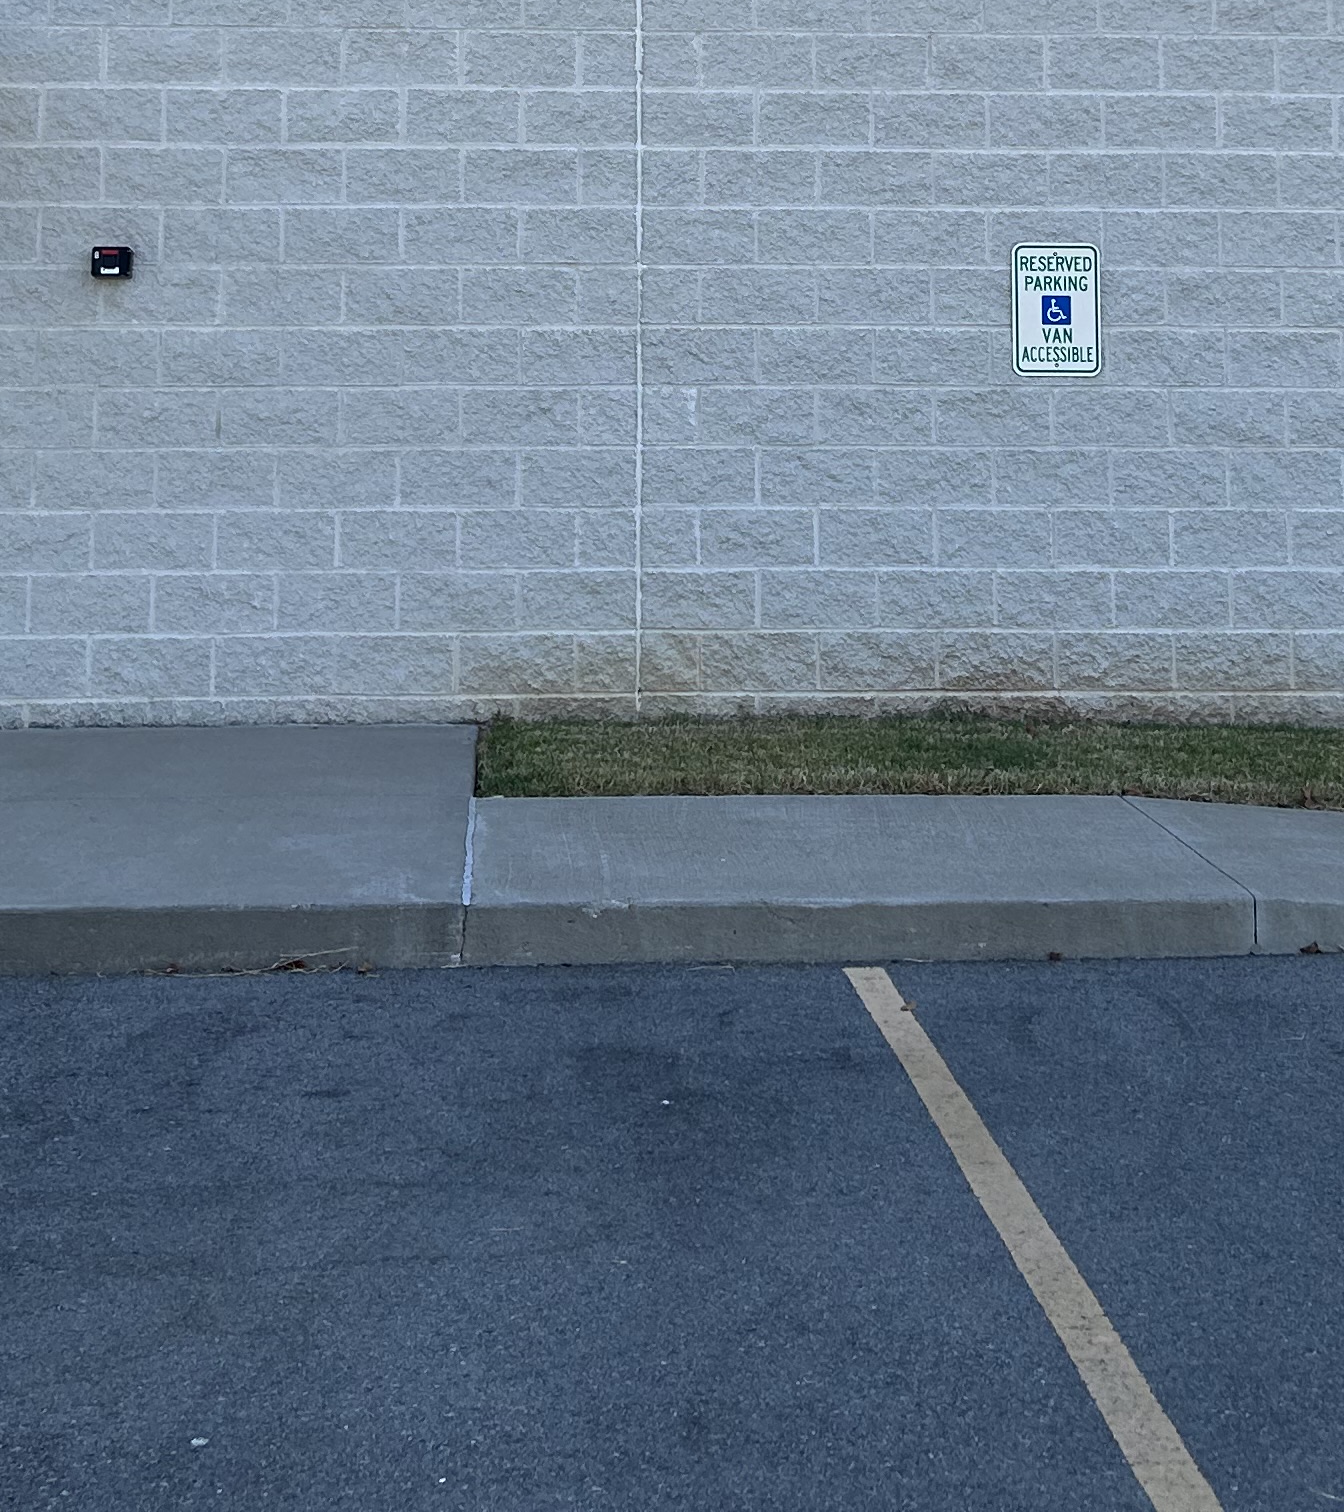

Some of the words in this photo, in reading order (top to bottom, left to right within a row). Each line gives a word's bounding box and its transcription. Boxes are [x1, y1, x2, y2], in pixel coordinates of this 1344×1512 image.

[1019, 255, 1093, 272] RESERVED
[1024, 275, 1089, 292] PARKING
[1042, 327, 1073, 344] VAN
[1021, 346, 1094, 363] ACCESSIBLE
